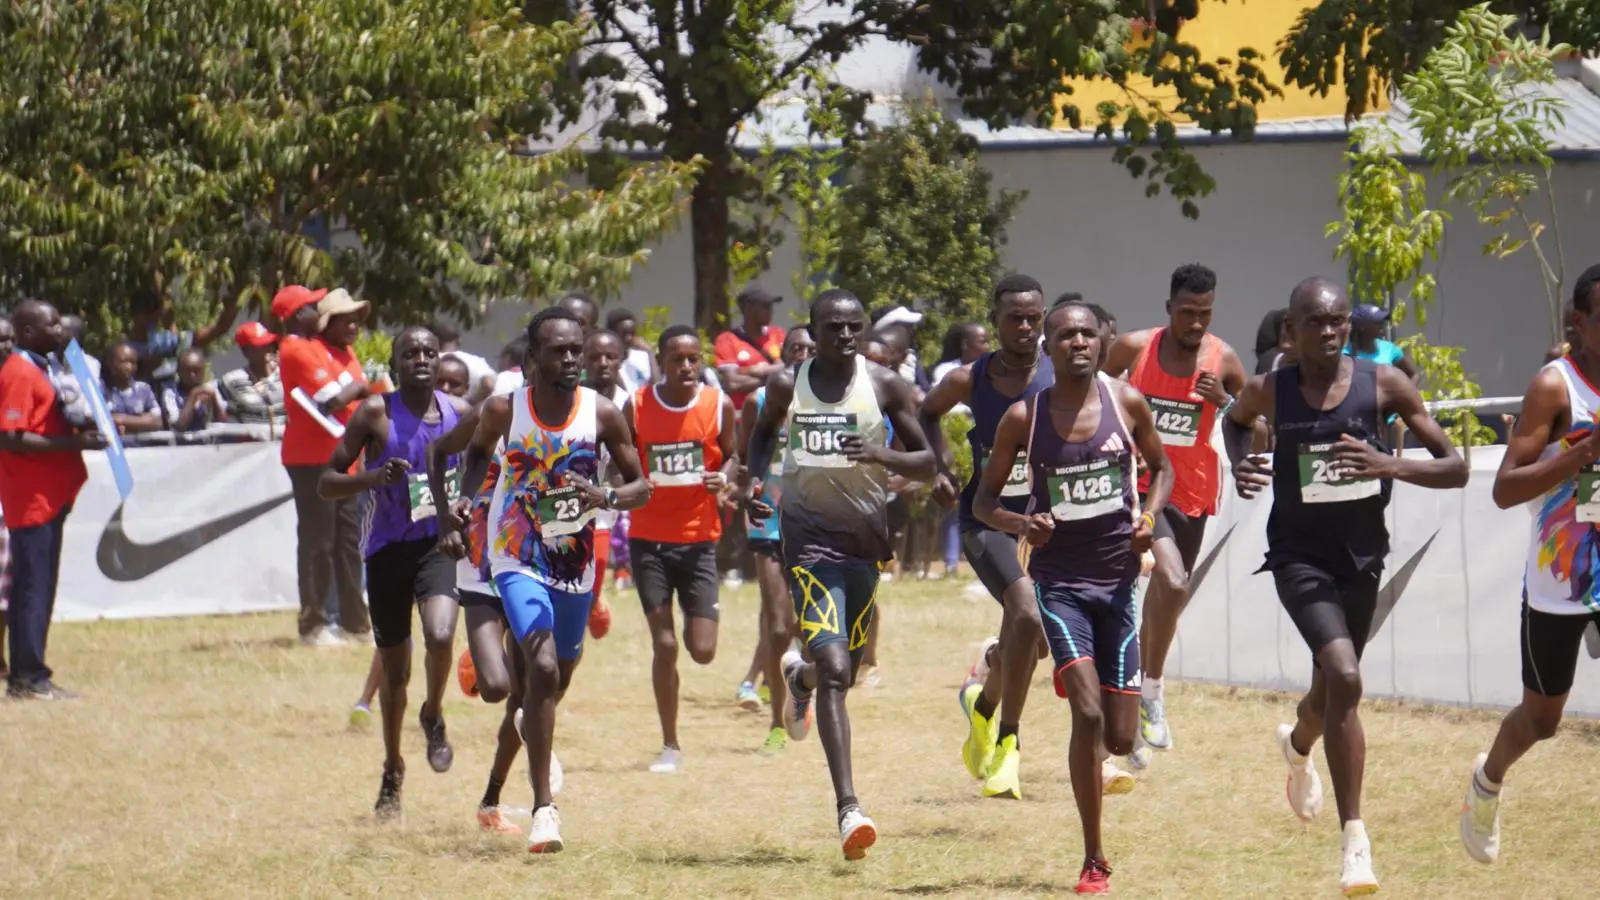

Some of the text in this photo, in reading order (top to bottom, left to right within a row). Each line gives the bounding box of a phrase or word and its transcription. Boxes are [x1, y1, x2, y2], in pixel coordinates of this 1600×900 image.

[1151, 410, 1193, 432] 1422
[655, 452, 694, 472] 1121
[1055, 463, 1088, 475] DISCOVERY
[1058, 474, 1112, 503] 1426
